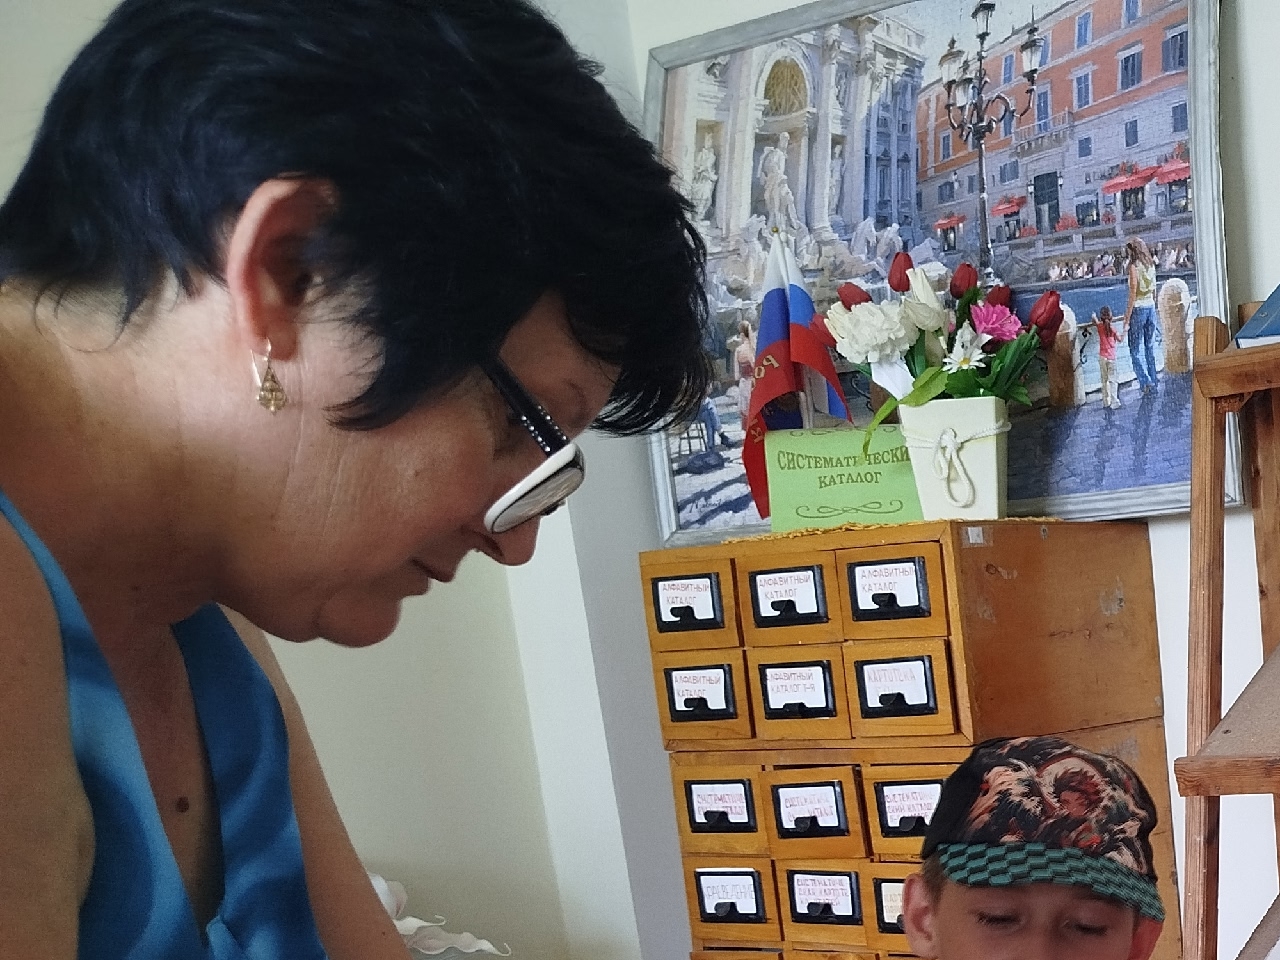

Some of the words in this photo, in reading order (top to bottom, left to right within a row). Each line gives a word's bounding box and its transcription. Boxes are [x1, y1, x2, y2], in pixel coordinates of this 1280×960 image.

[818, 472, 882, 489] КАТАЛОГ
[862, 582, 897, 592] КАТАЛОГ
[764, 588, 798, 600] КАТАЛОГ
